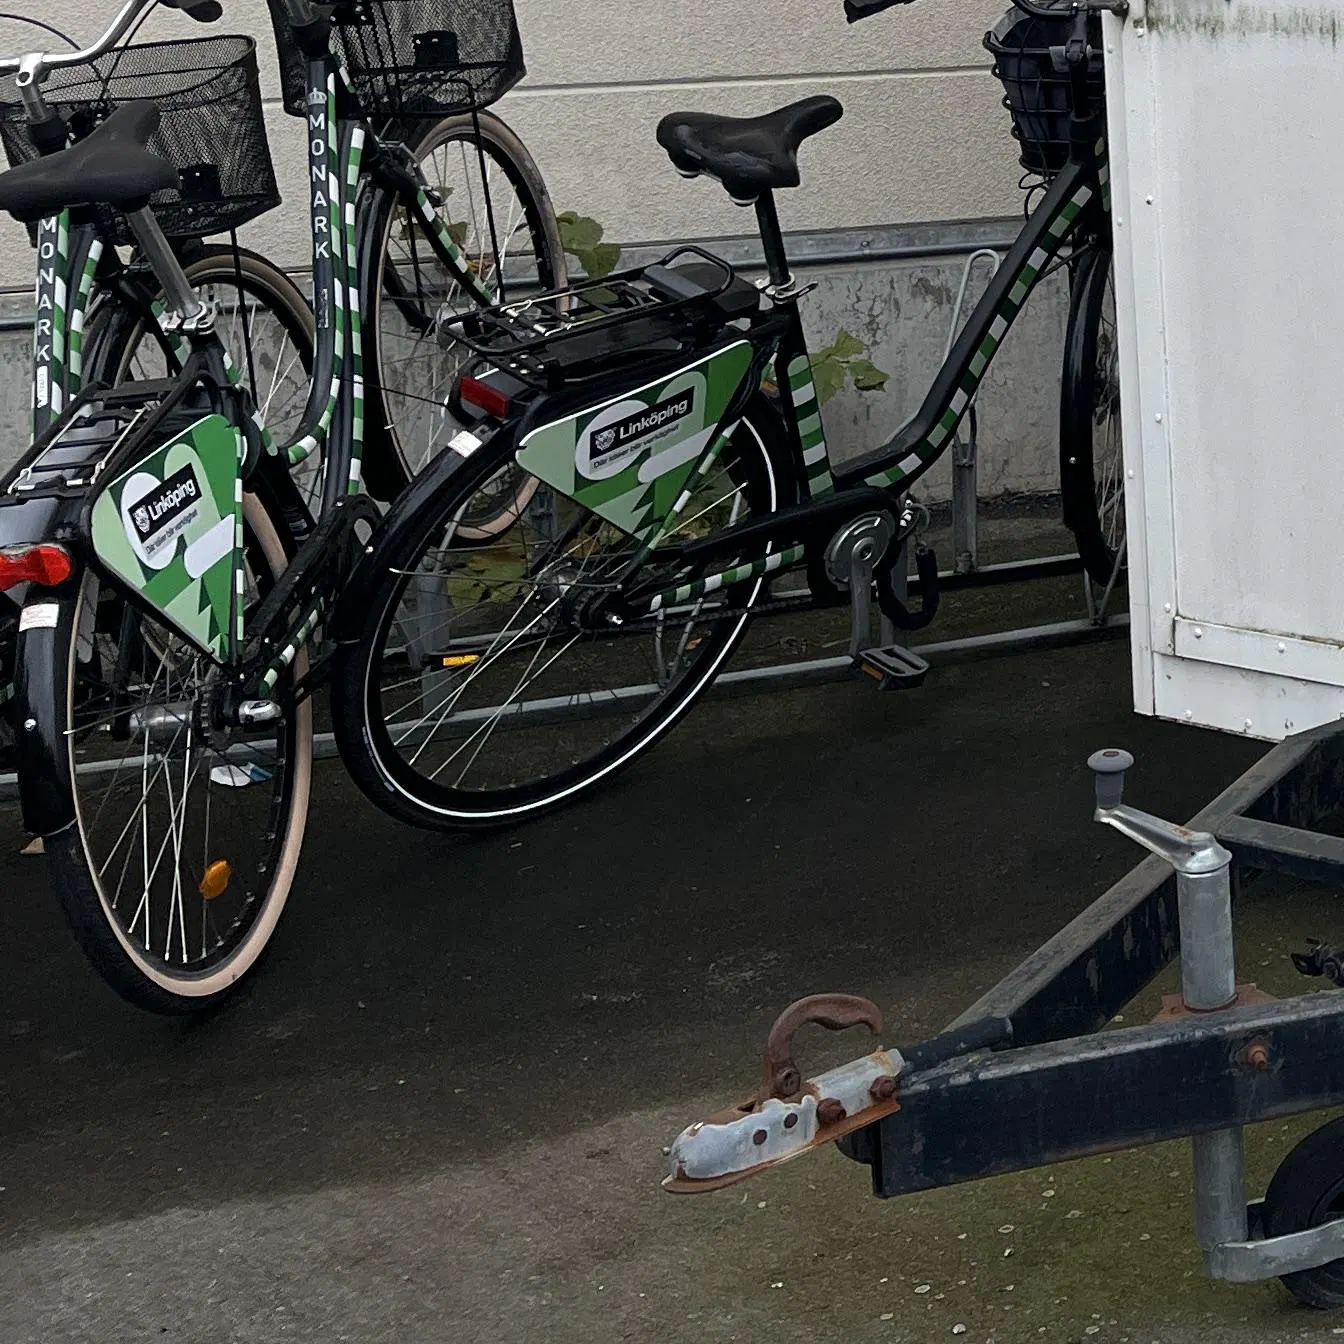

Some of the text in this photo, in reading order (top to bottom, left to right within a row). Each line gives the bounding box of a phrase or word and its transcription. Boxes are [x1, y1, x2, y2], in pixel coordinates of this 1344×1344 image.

[309, 112, 329, 259] MONARK
[37, 216, 57, 362] MONARK
[619, 399, 689, 440] Linköping
[147, 478, 197, 521] Linköping
